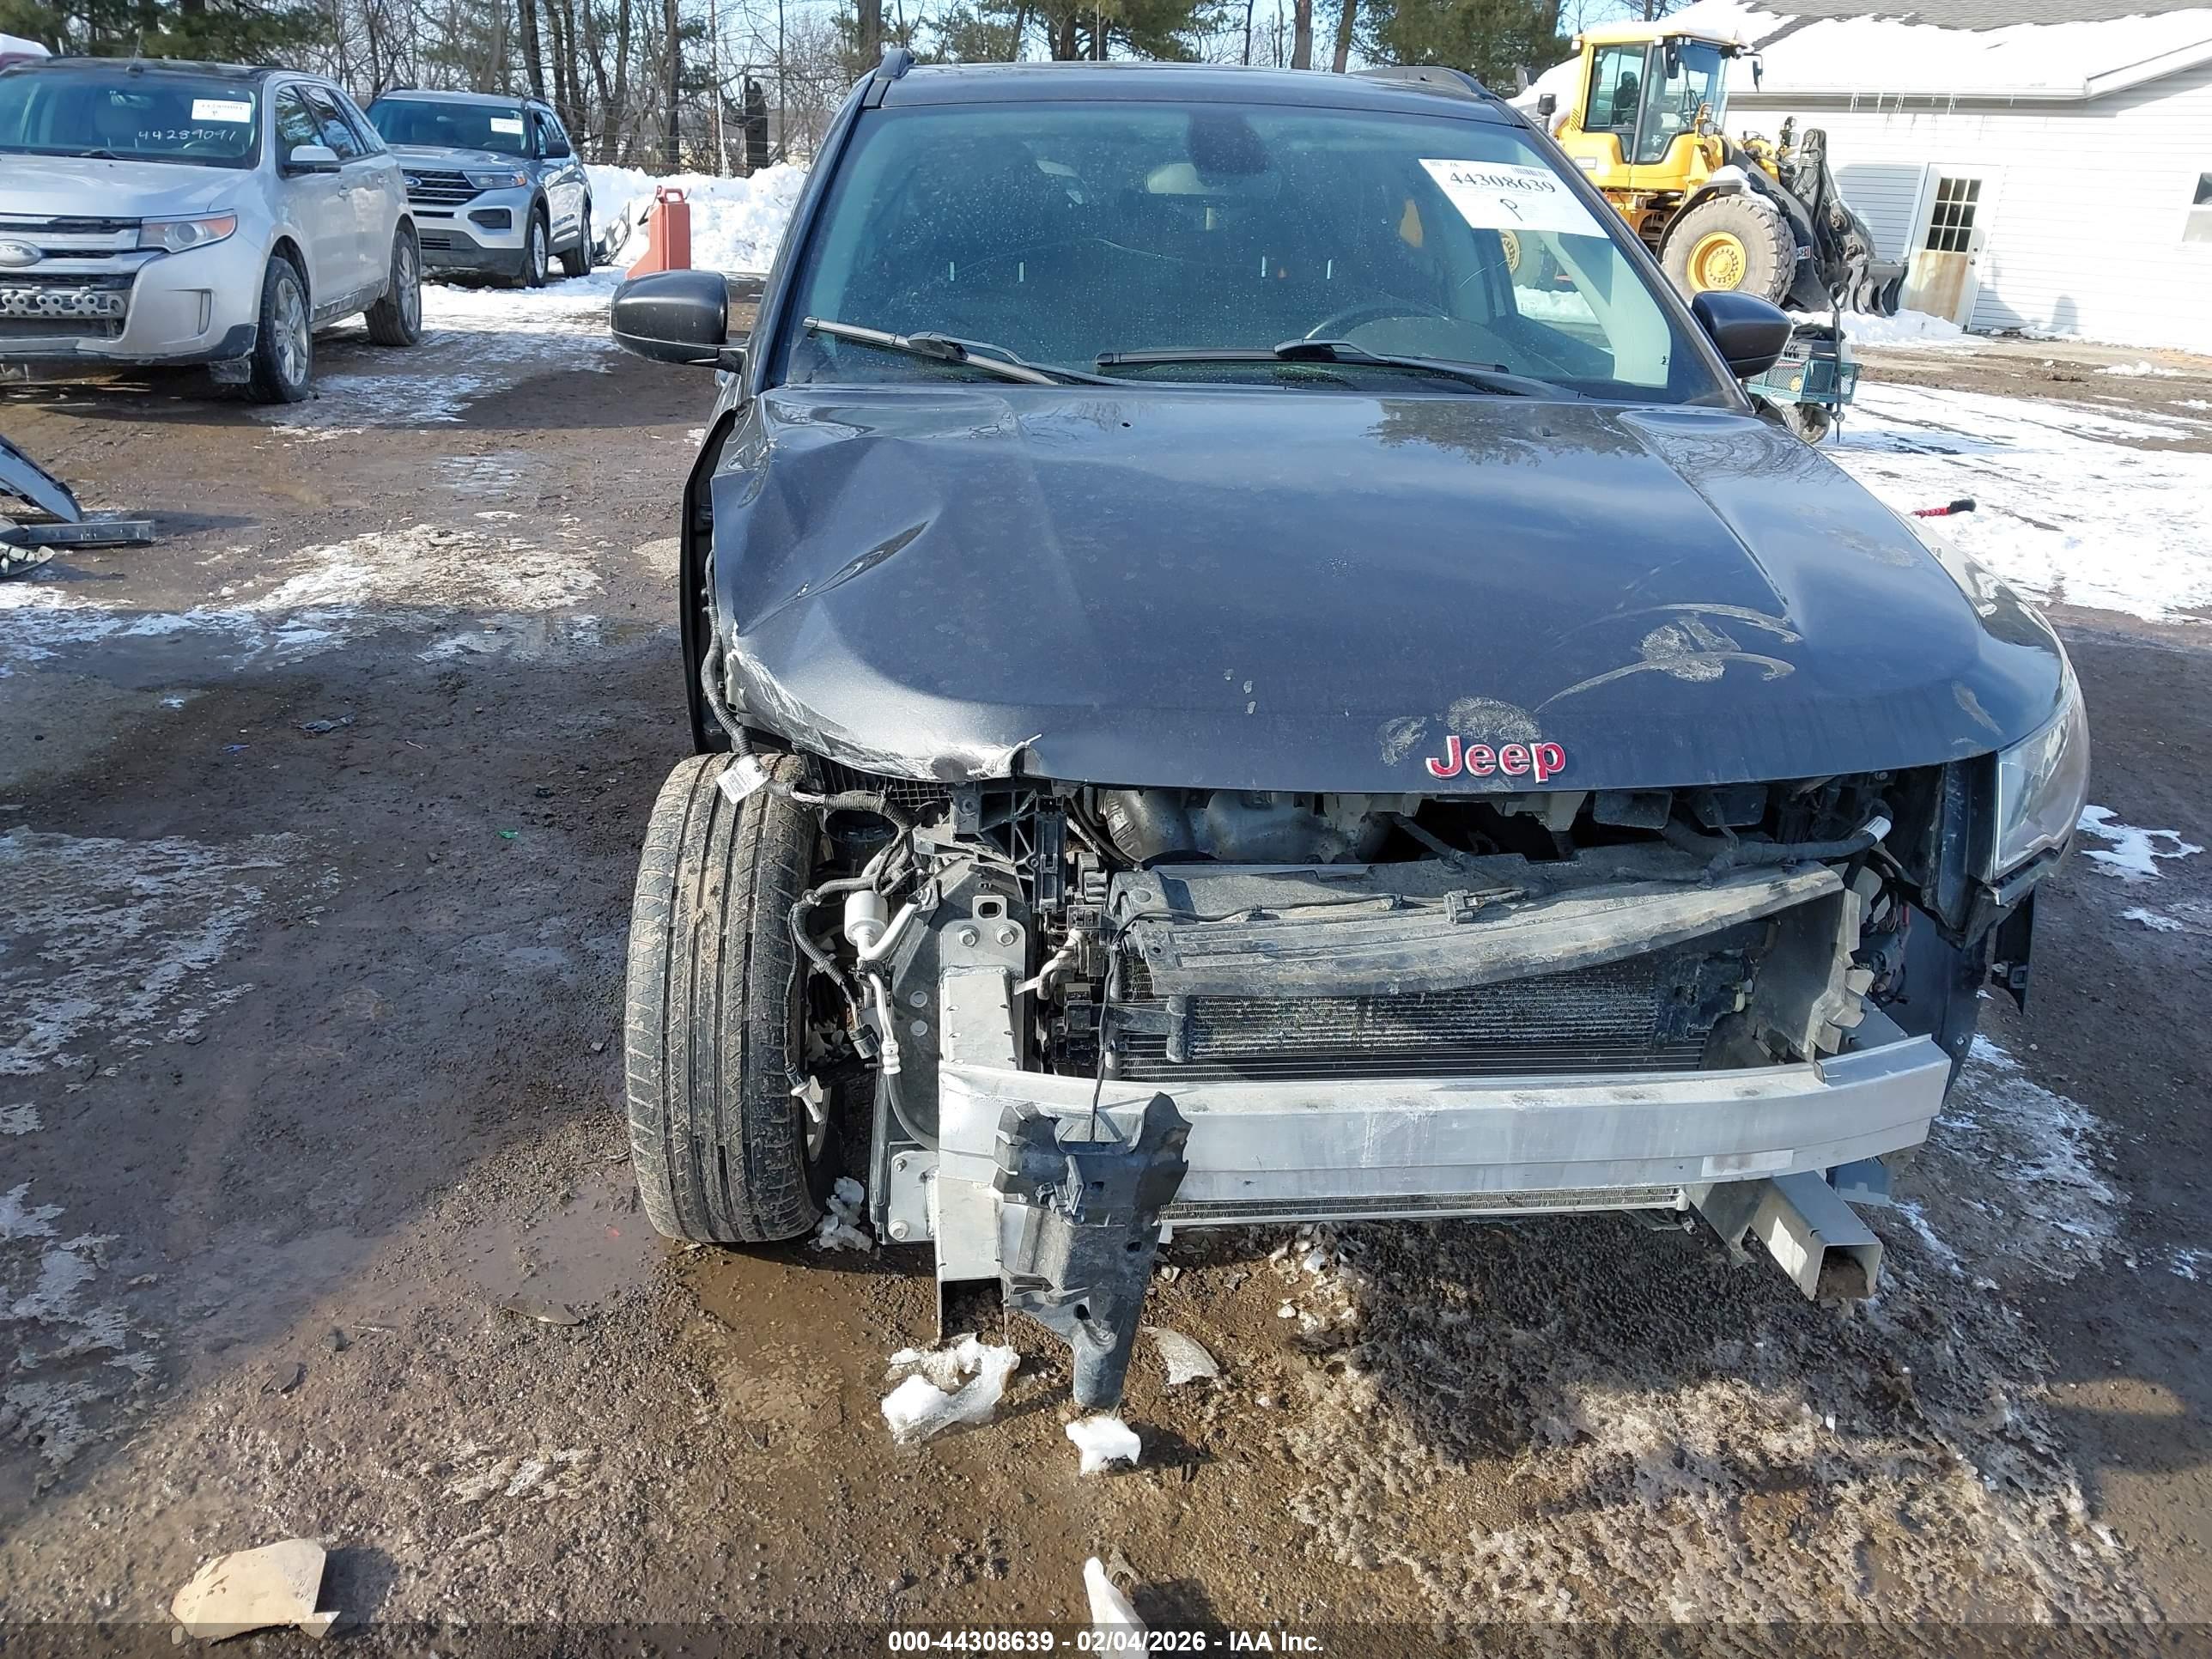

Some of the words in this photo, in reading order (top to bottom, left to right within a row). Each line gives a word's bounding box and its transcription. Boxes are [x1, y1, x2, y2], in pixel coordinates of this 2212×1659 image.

[137, 128, 237, 142] 44289091
[1449, 171, 1557, 194] 44308639
[1425, 735, 1566, 784] Jeep
